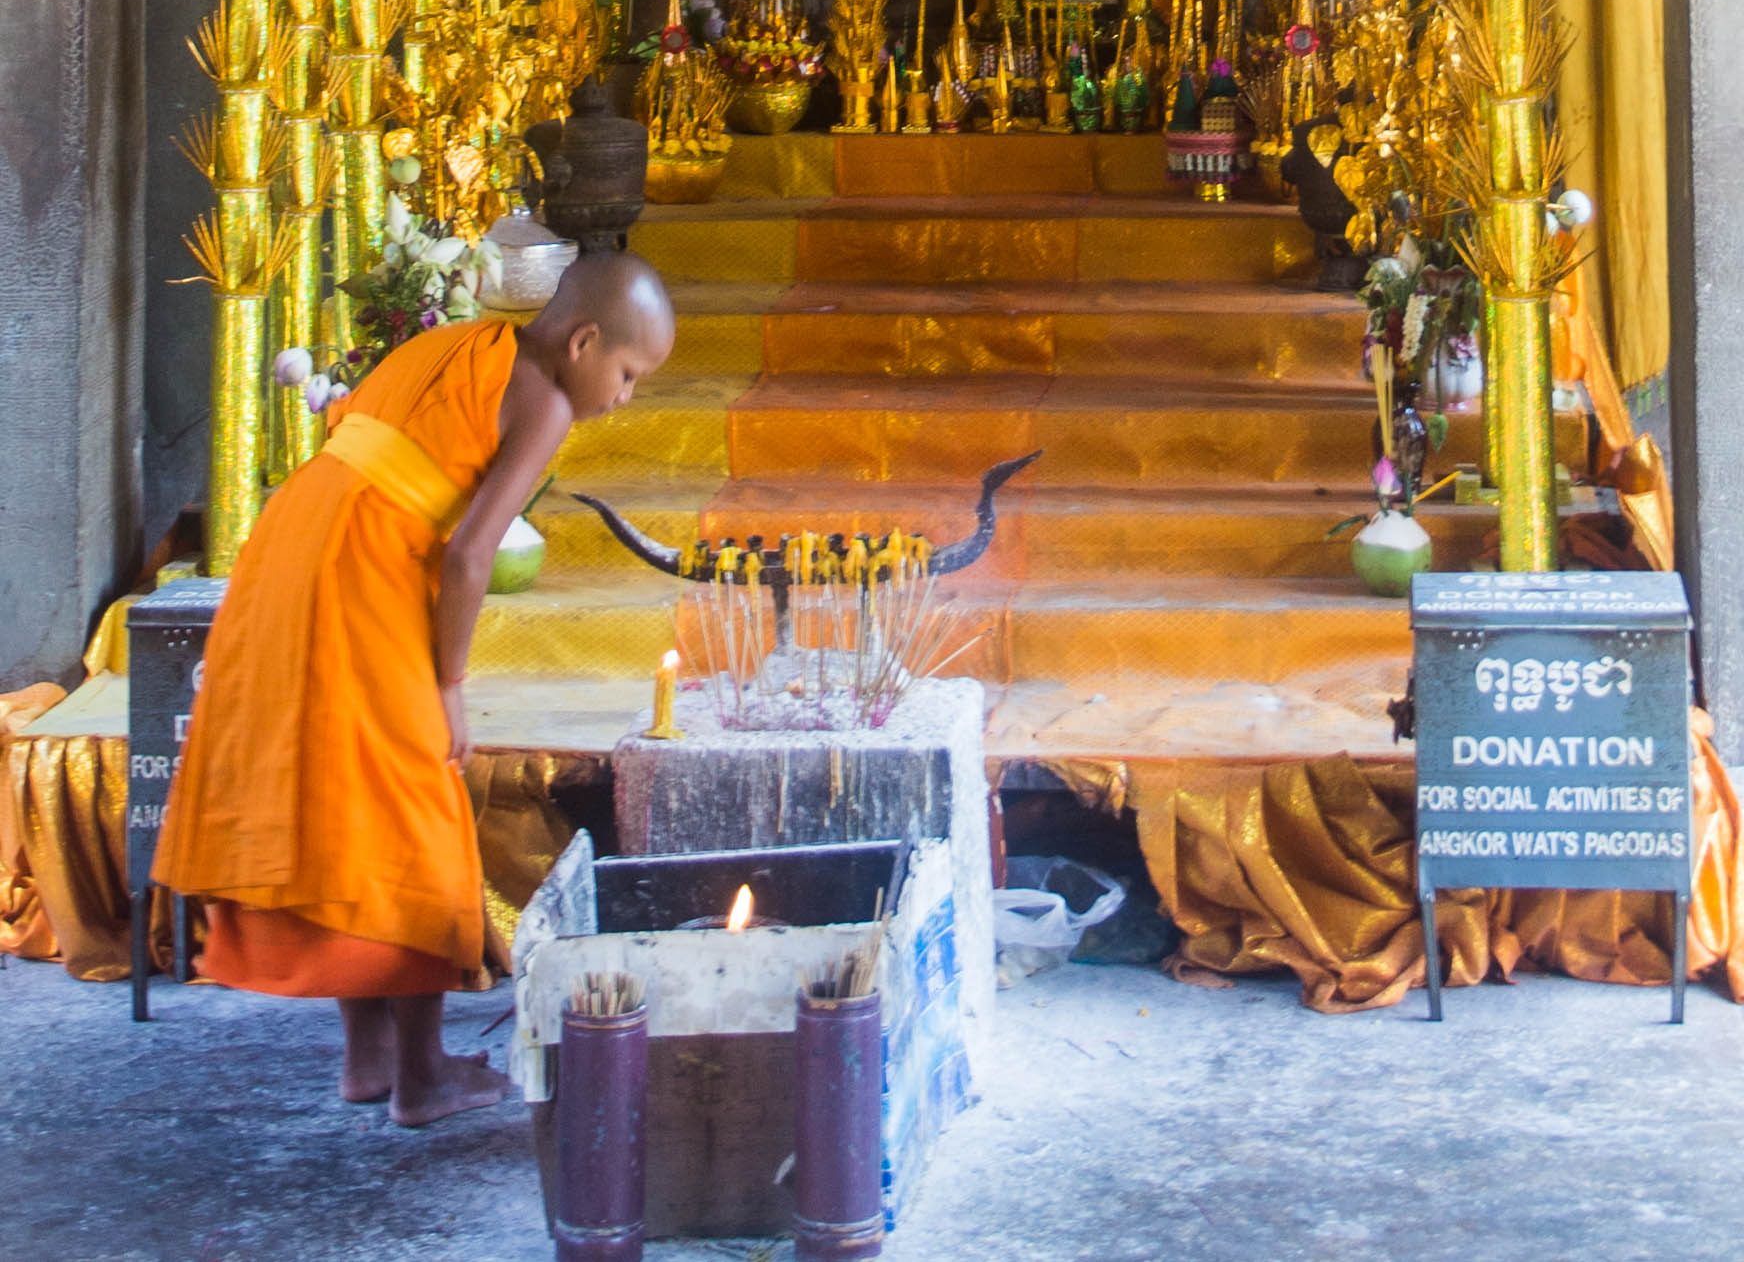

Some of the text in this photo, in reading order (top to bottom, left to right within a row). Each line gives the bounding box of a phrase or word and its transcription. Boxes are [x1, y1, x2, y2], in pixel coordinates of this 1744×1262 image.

[1416, 601, 1685, 612] ANGKOR WAT'S PAGODAS
[1437, 590, 1635, 601] DONATION
[1452, 736, 1655, 767] DONATION
[131, 754, 171, 779] FOR
[1418, 785, 1685, 812] FOR SOCIAL ACTIVITIES OF
[1418, 831, 1687, 858] ANGKOR WAT'S PAGODAS
